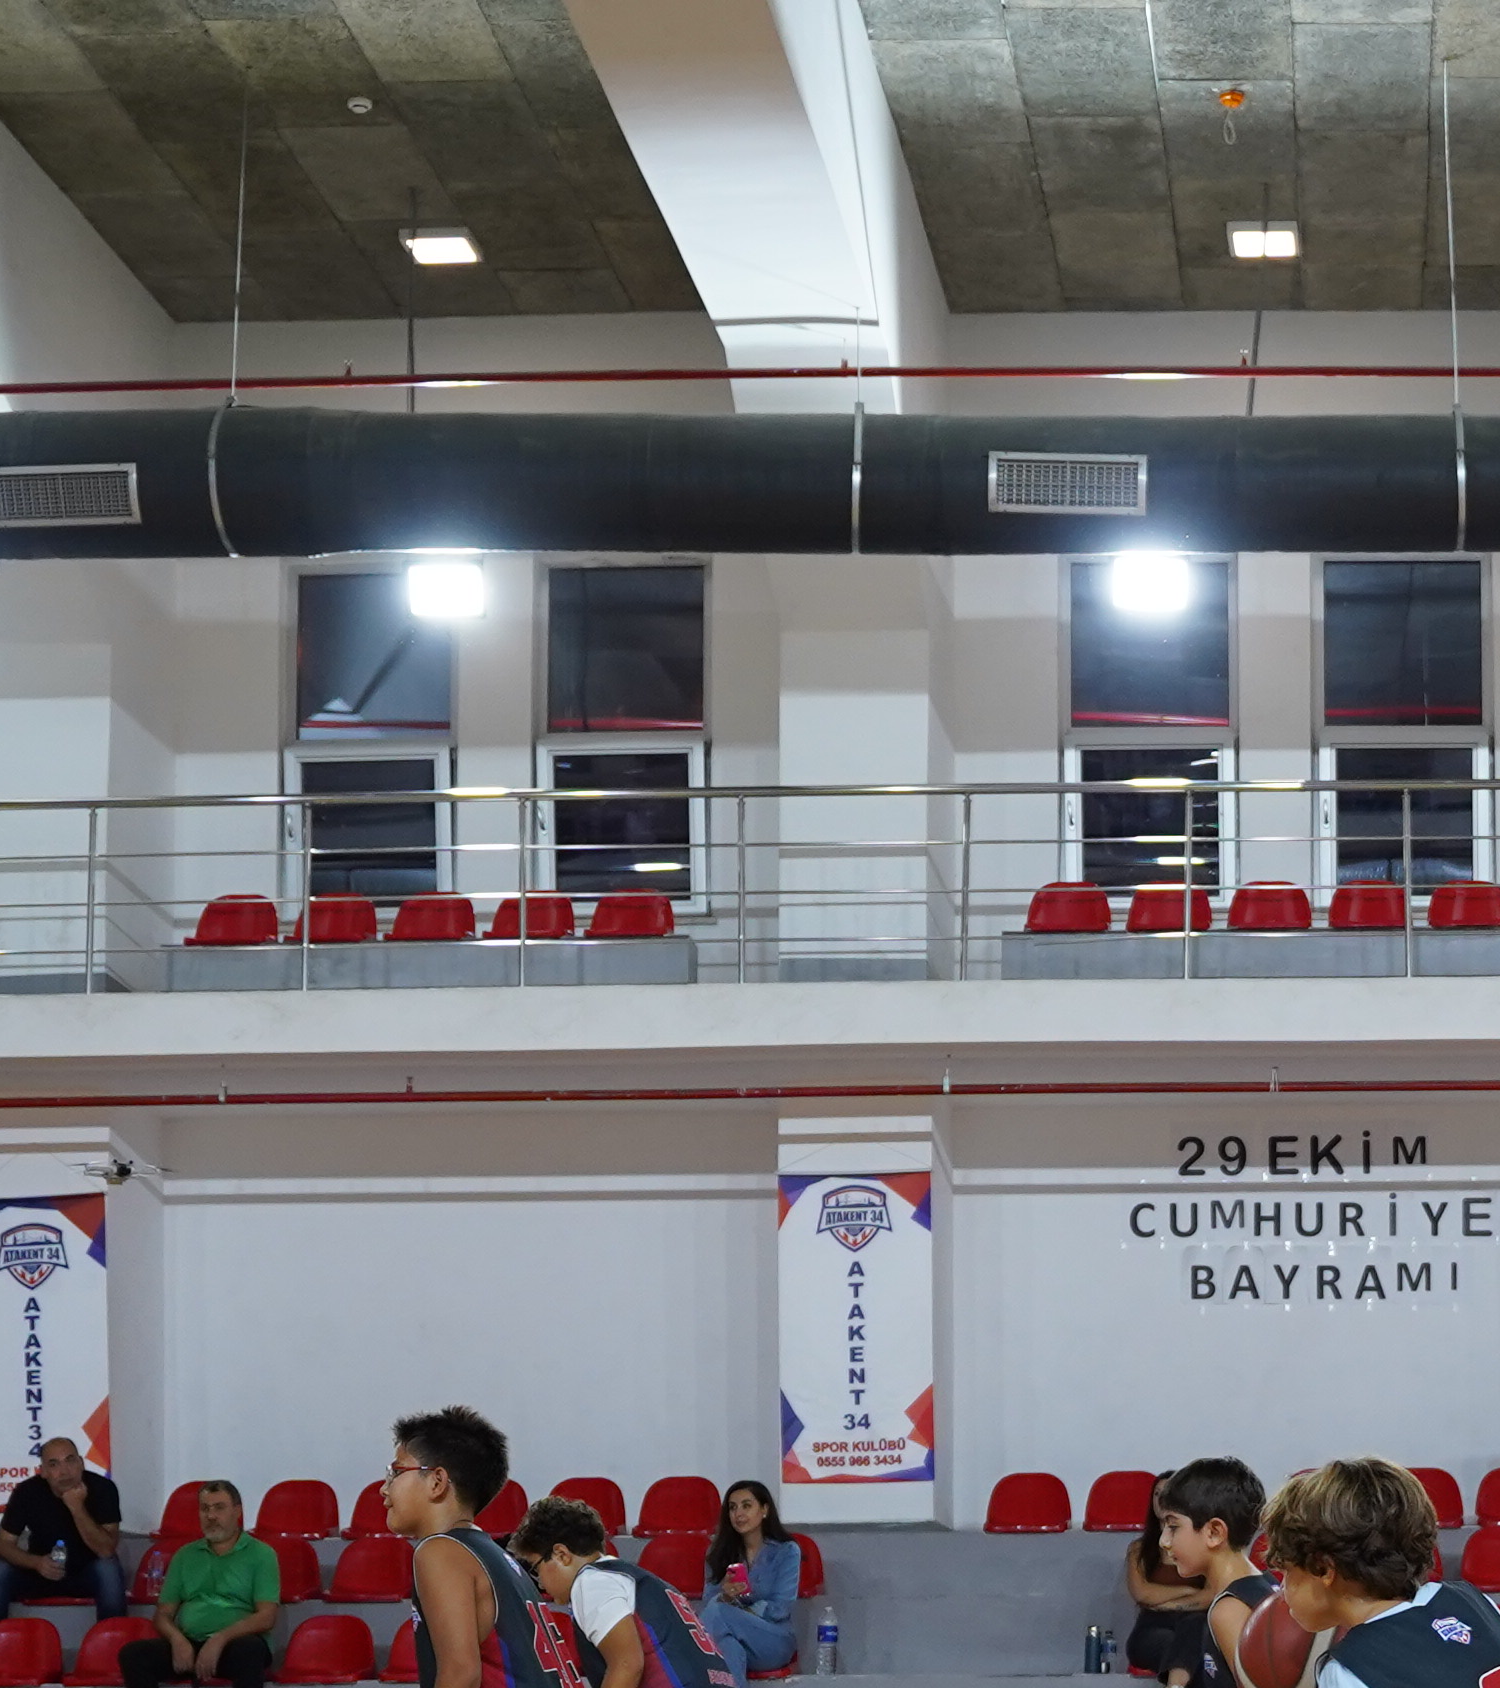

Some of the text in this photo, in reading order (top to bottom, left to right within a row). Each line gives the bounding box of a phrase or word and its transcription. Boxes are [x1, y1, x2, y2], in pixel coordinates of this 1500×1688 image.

[824, 1209, 868, 1226] ATAKENT
[1190, 1262, 1458, 1300] BAYRAMI
[847, 1261, 866, 1406] ATAKENT
[843, 1414, 871, 1431] 34
[812, 1438, 906, 1453] SPOR KULÜBÜ
[817, 1457, 846, 1468] 0555
[874, 1454, 902, 1465] 3434
